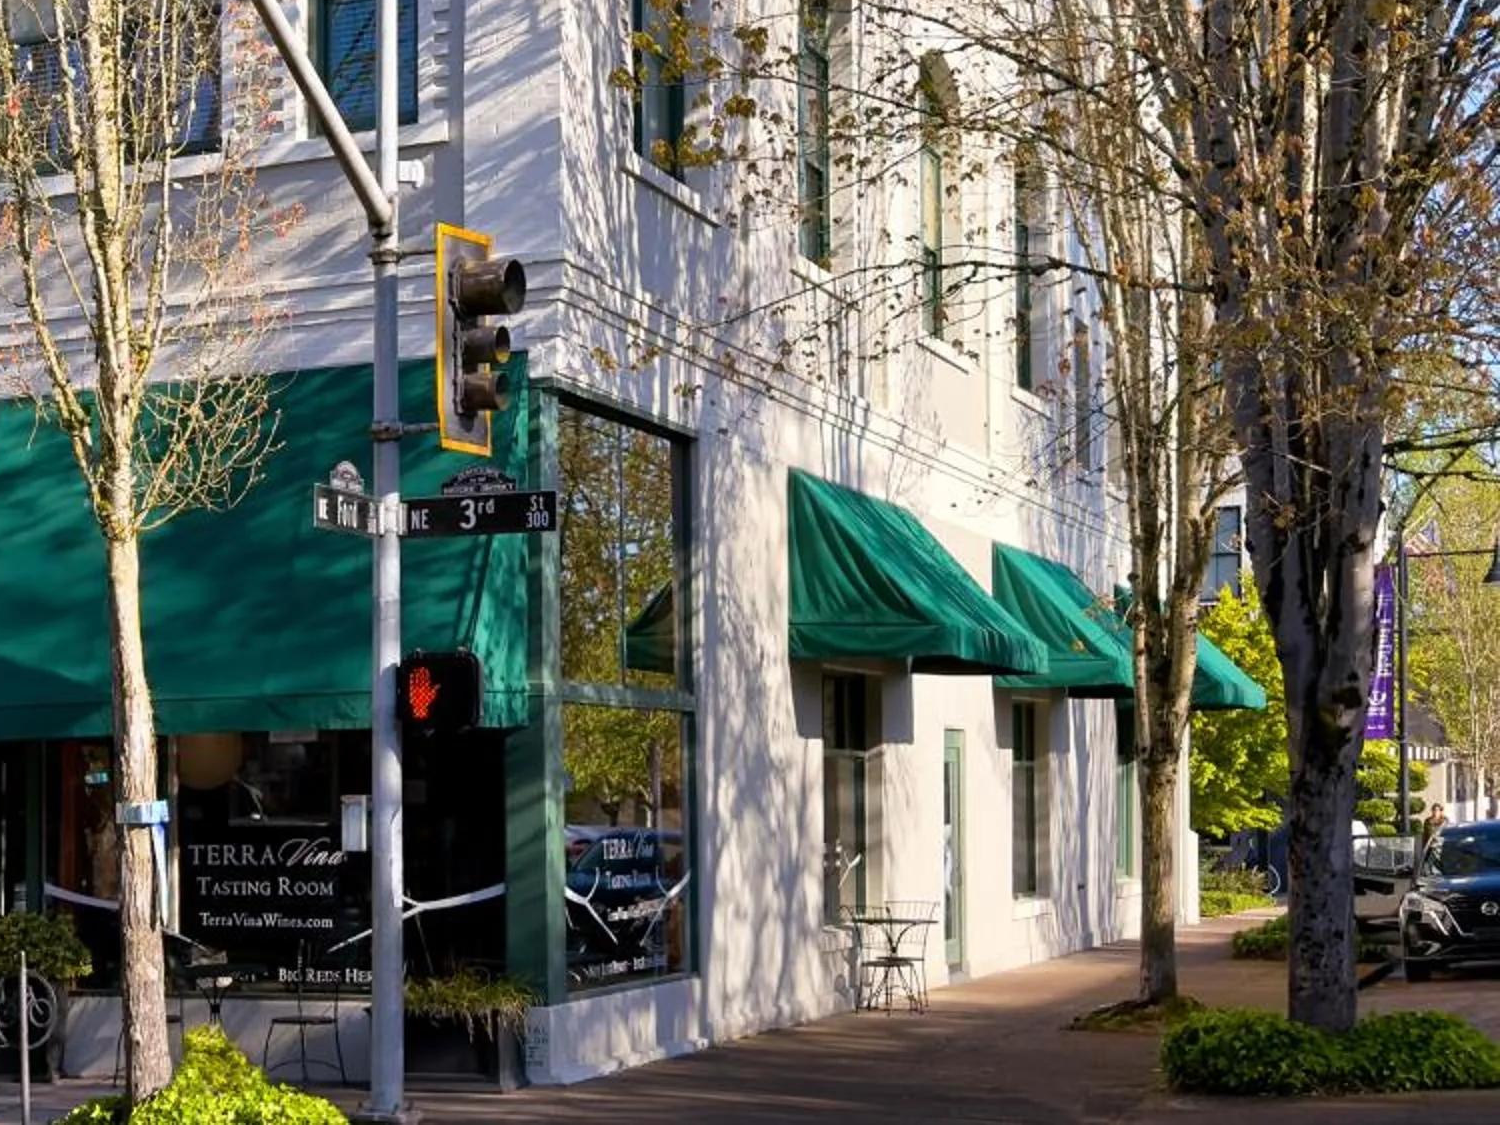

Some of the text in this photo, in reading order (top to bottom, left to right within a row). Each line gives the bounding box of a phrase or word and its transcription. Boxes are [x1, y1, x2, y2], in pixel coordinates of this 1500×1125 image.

[411, 495, 545, 530] NE 3rd St
[525, 512, 549, 528] 300
[188, 837, 346, 867] TERRA Vina
[196, 876, 334, 896] TASTING ROOM
[198, 912, 334, 928] TerraVinaWines.com
[279, 968, 300, 983] BIG
[305, 968, 341, 983] REDS
